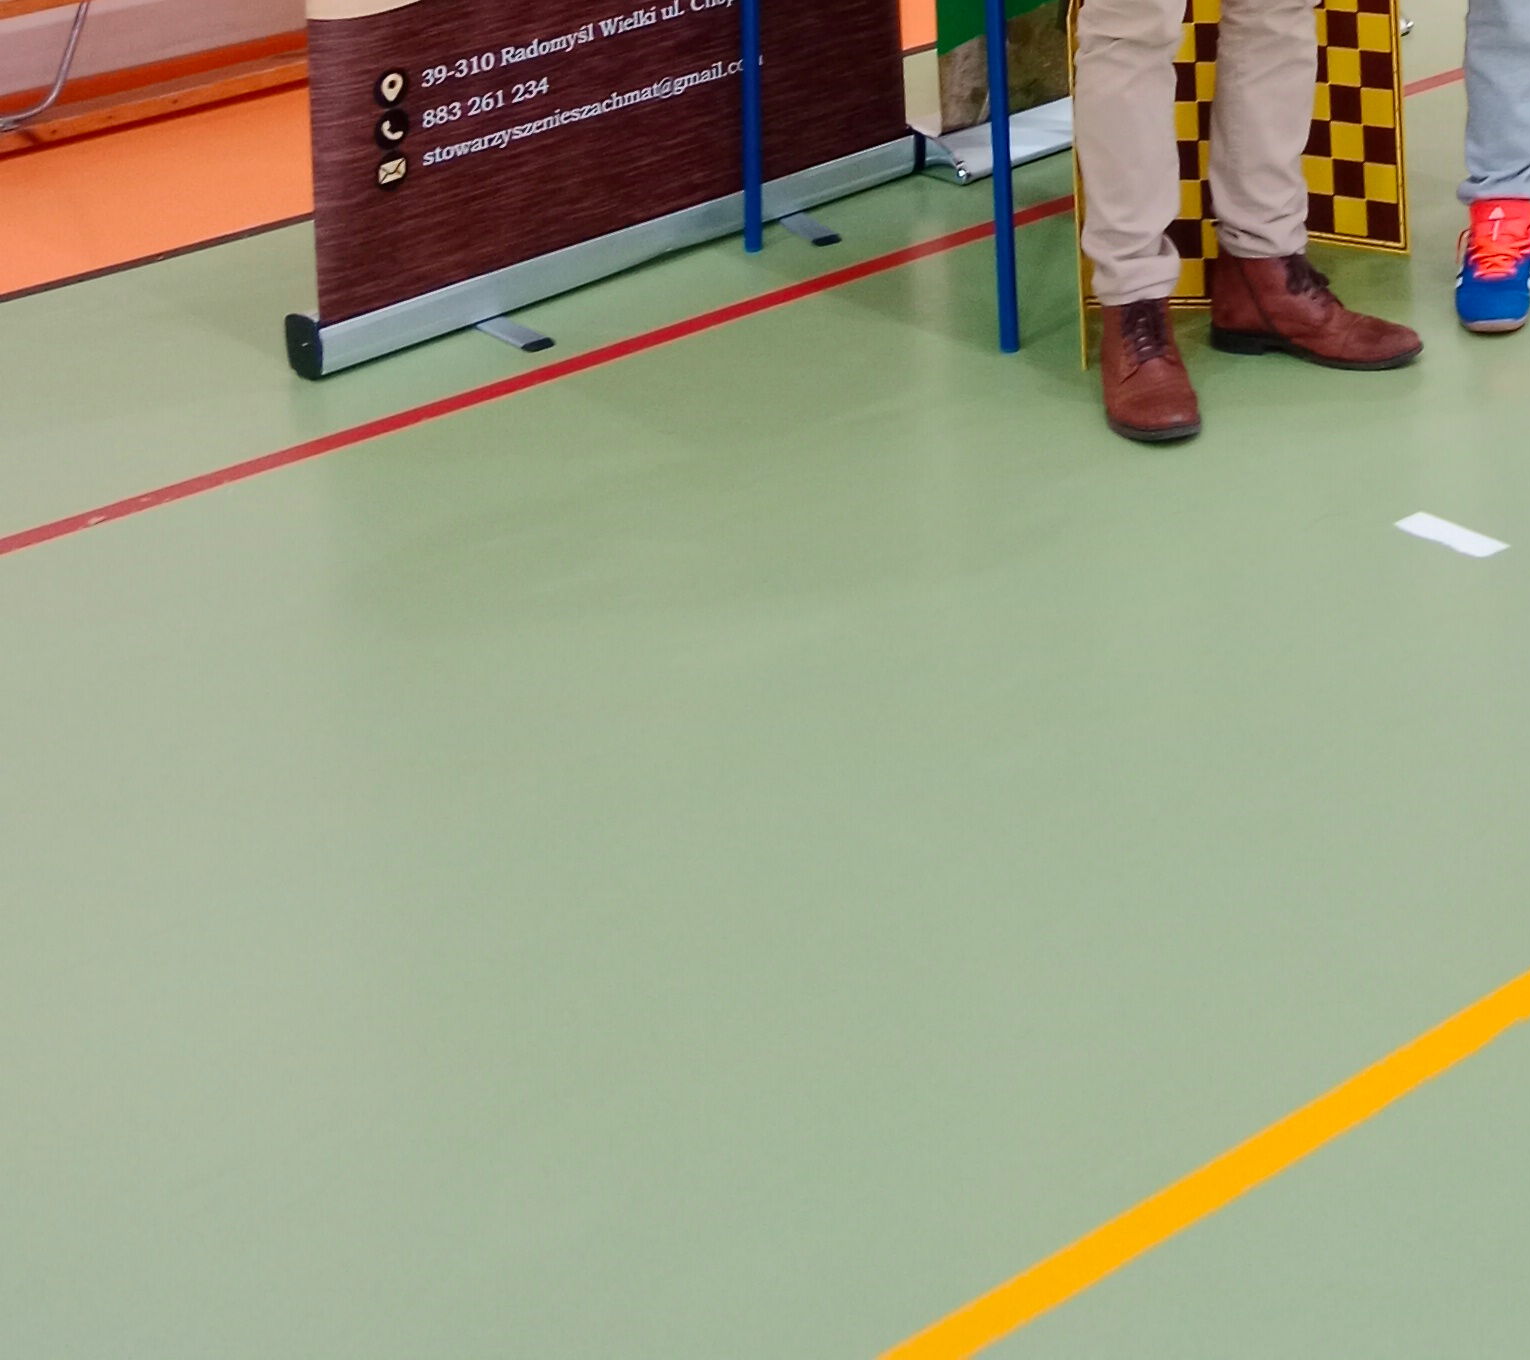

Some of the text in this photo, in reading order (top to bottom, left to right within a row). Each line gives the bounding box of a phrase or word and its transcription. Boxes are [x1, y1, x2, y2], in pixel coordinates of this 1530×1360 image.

[421, 51, 496, 88] 39-310
[499, 22, 595, 67] Radomyśl
[599, 6, 657, 38] Wielki
[662, 0, 686, 21] ul.
[422, 76, 551, 129] 883 261 234
